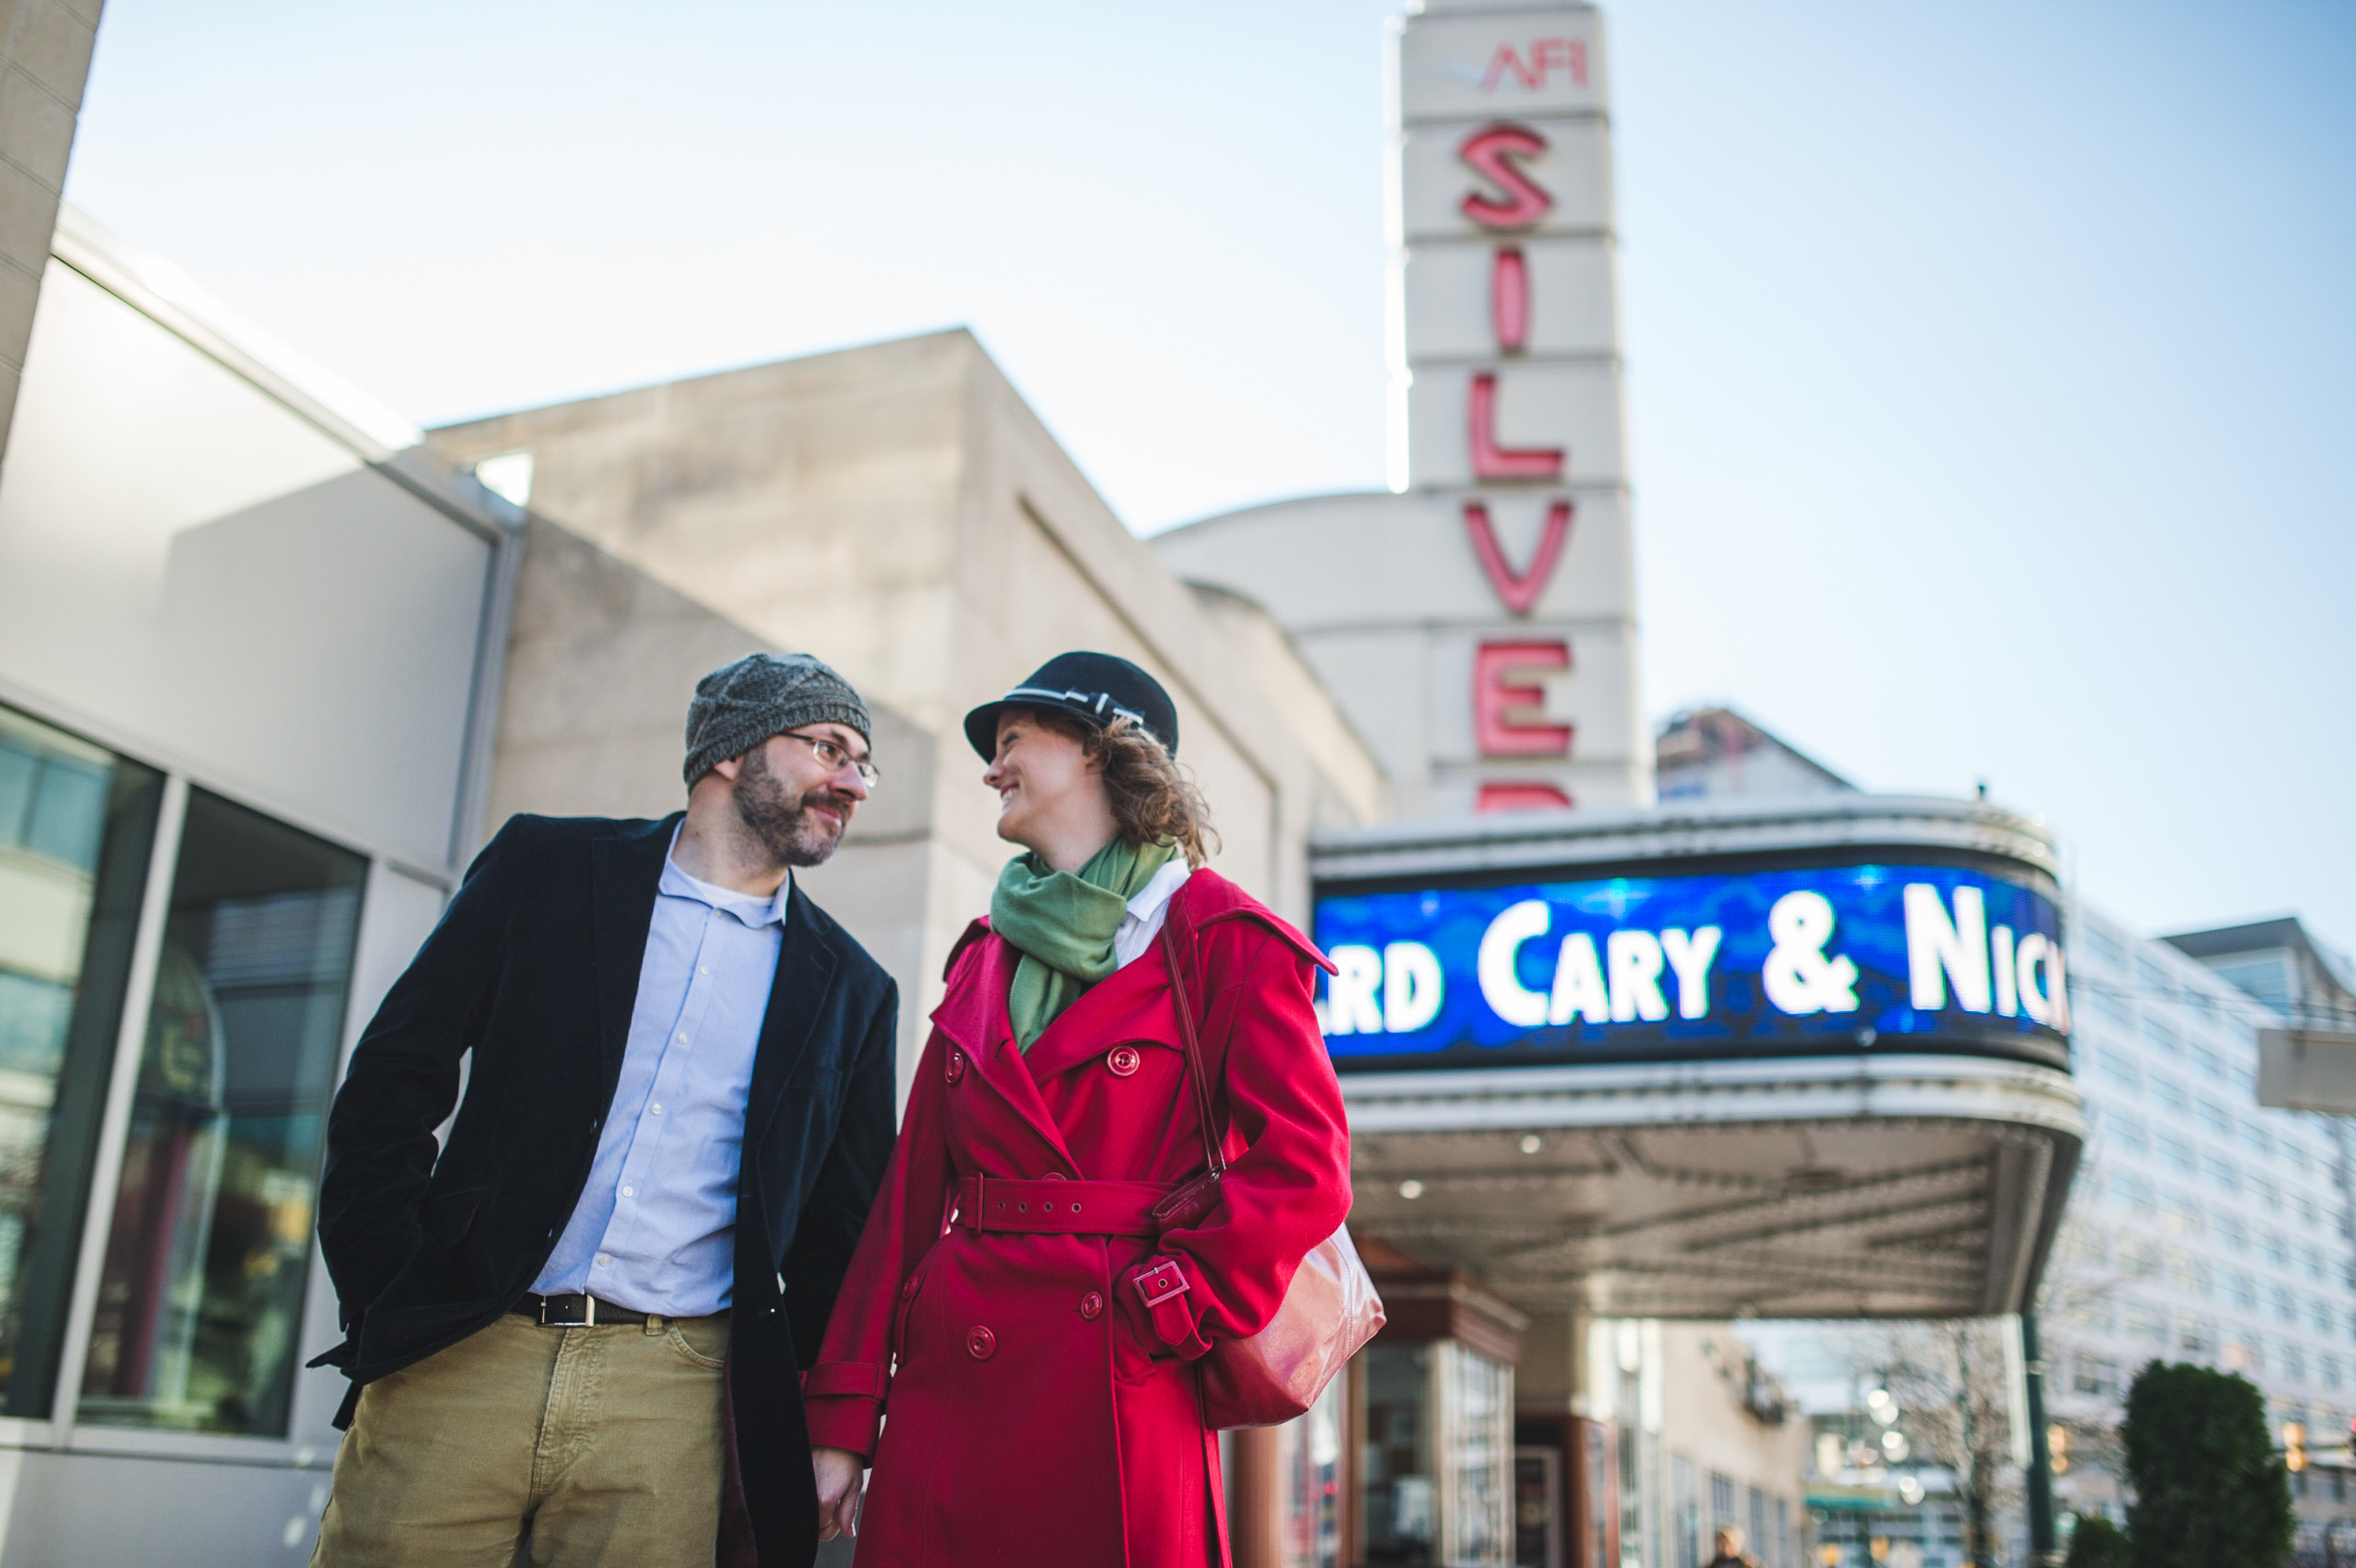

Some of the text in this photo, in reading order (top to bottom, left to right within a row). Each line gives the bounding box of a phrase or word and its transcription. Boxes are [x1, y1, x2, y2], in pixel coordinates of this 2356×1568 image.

[1481, 39, 1589, 91] AFI
[1458, 122, 1573, 814] SILVE
[1478, 900, 1722, 1027] CARY
[1762, 890, 1860, 1015] &
